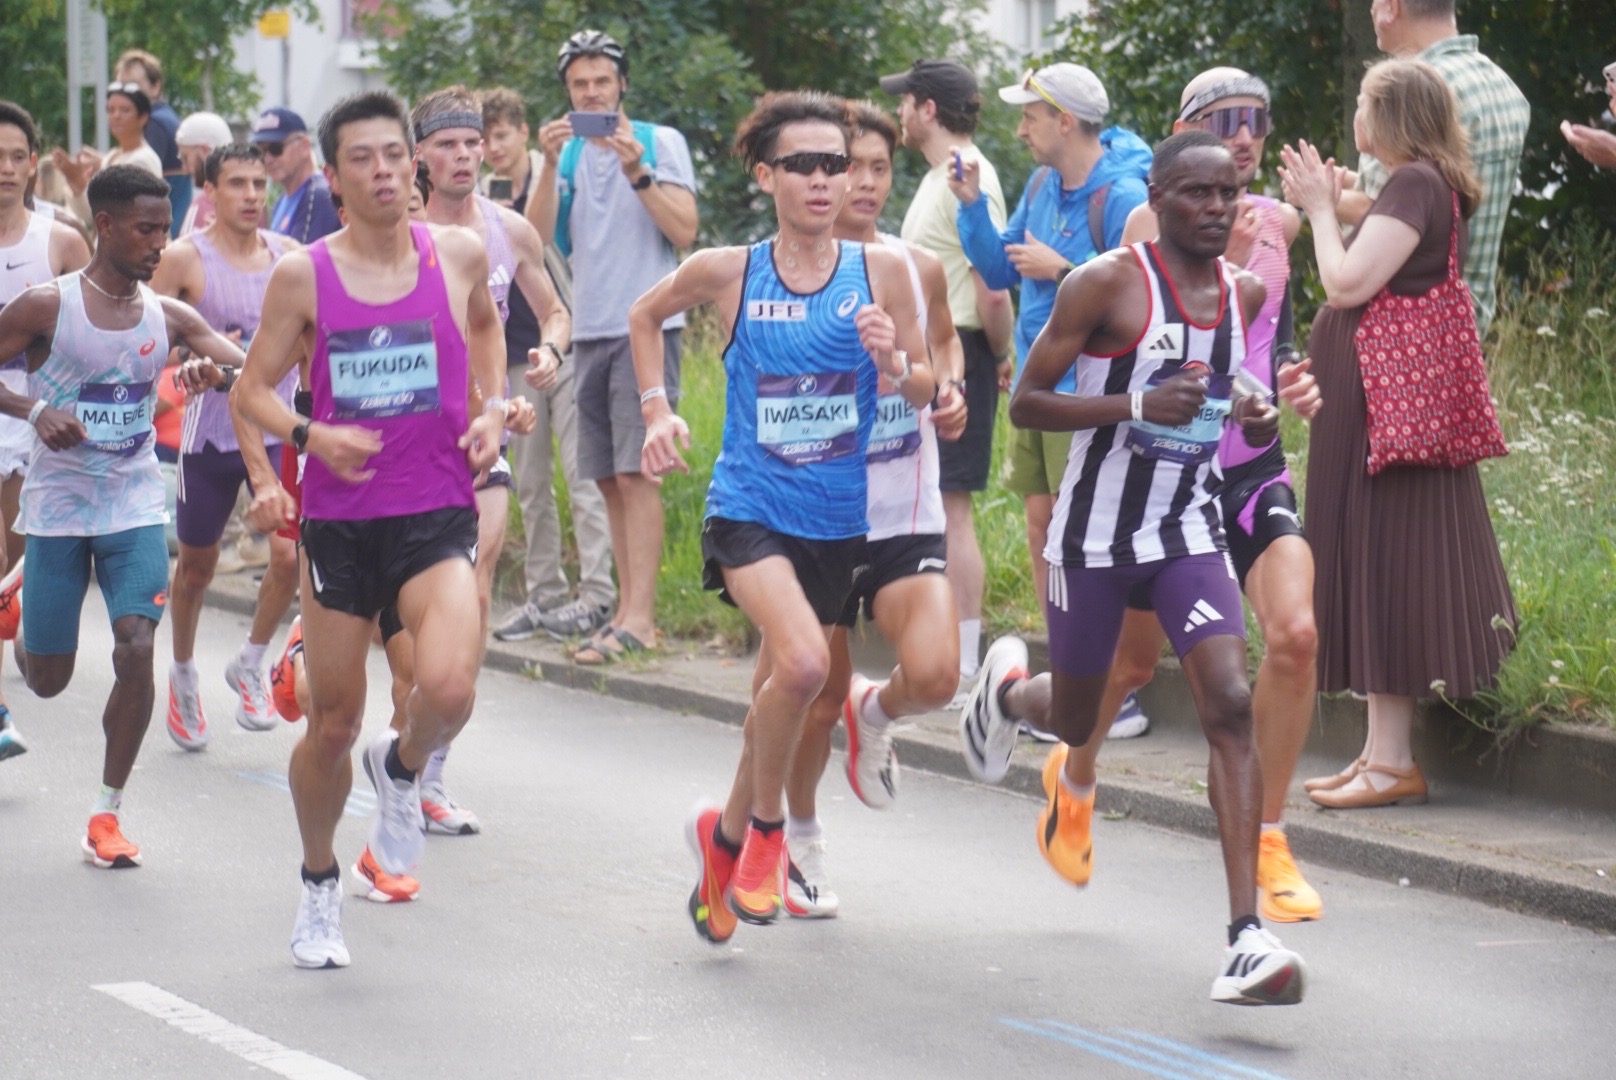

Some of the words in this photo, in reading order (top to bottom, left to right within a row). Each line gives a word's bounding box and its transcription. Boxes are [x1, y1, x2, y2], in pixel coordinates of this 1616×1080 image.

[750, 303, 804, 319] JFE
[338, 353, 429, 379] FUKUDA
[764, 403, 849, 424] IWASAKI
[875, 399, 914, 424] NJIE
[1152, 437, 1203, 455] zalando
